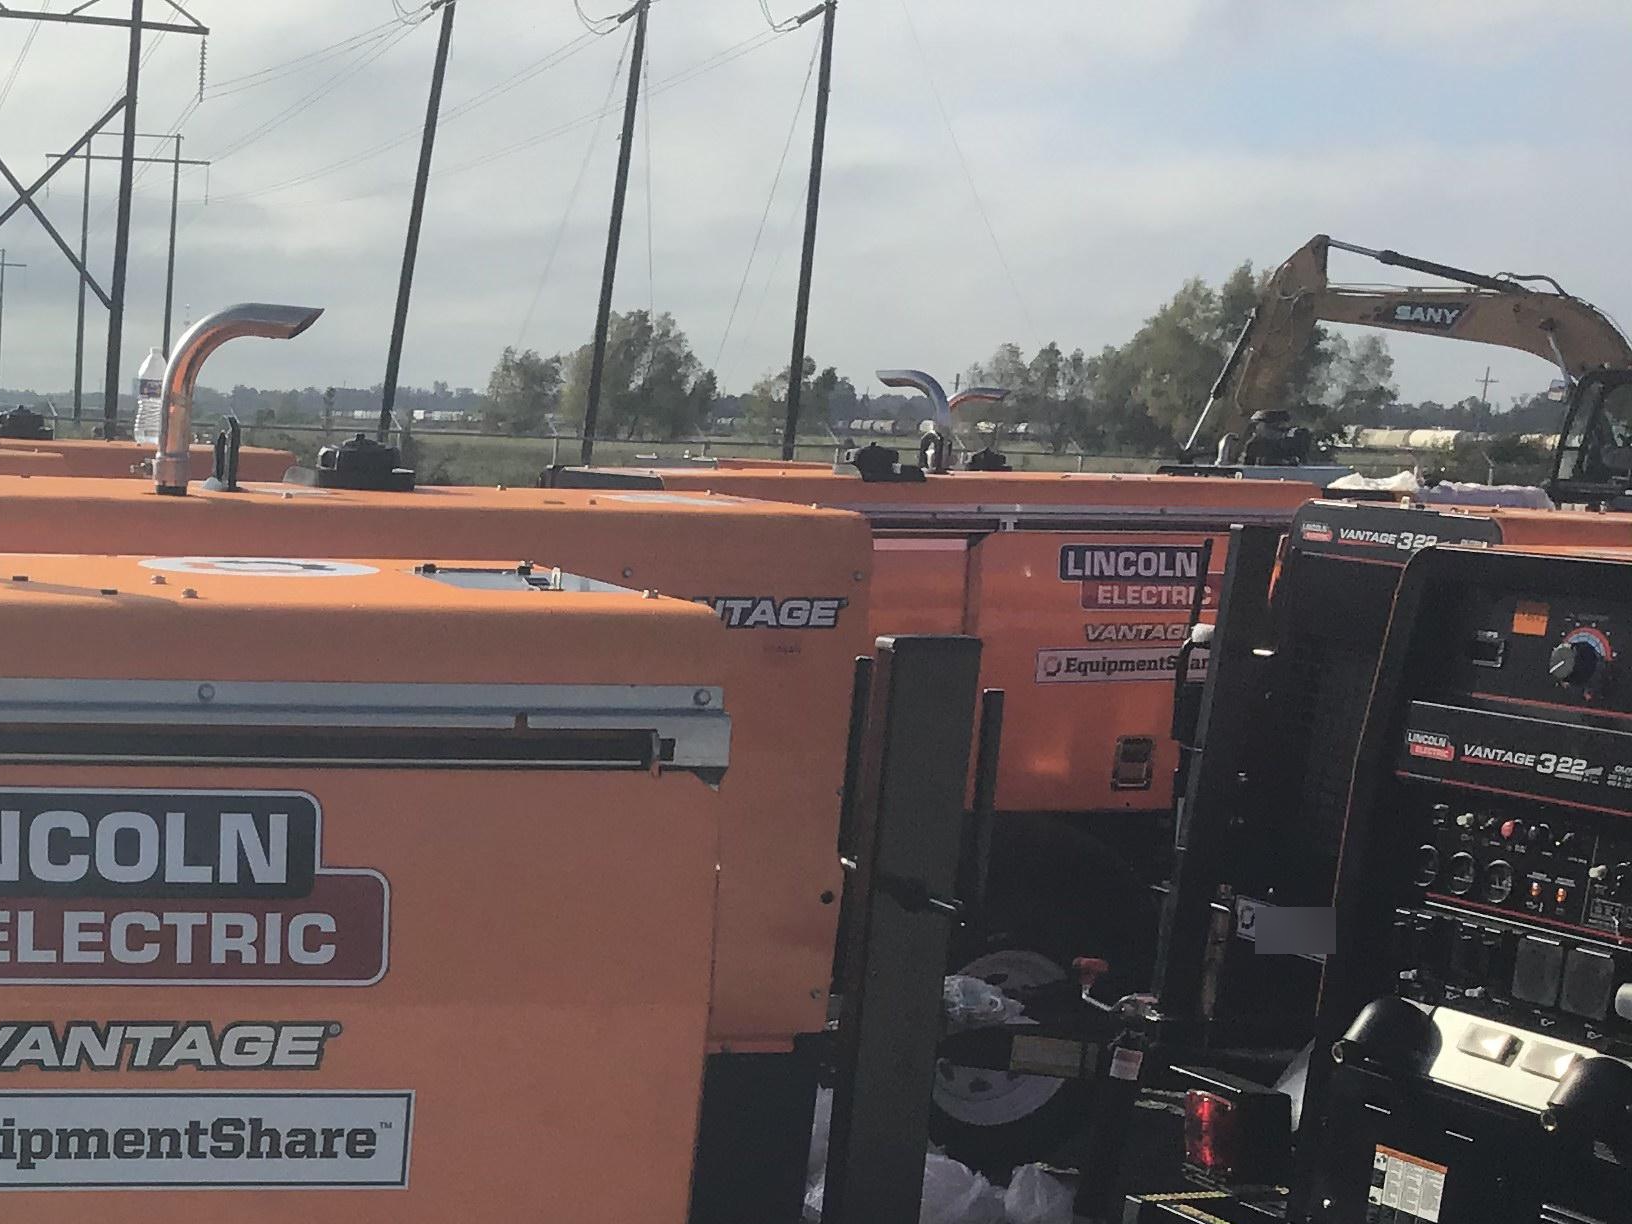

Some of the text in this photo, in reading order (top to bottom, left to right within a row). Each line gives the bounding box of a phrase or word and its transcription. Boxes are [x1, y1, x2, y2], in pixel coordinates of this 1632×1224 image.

[1394, 305, 1460, 324] SANY
[1339, 528, 1397, 545] VANTAGE
[1067, 551, 1198, 578] LINCOLN
[1407, 732, 1447, 748] LINCOLN
[1464, 743, 1588, 775] VANTAGE 322
